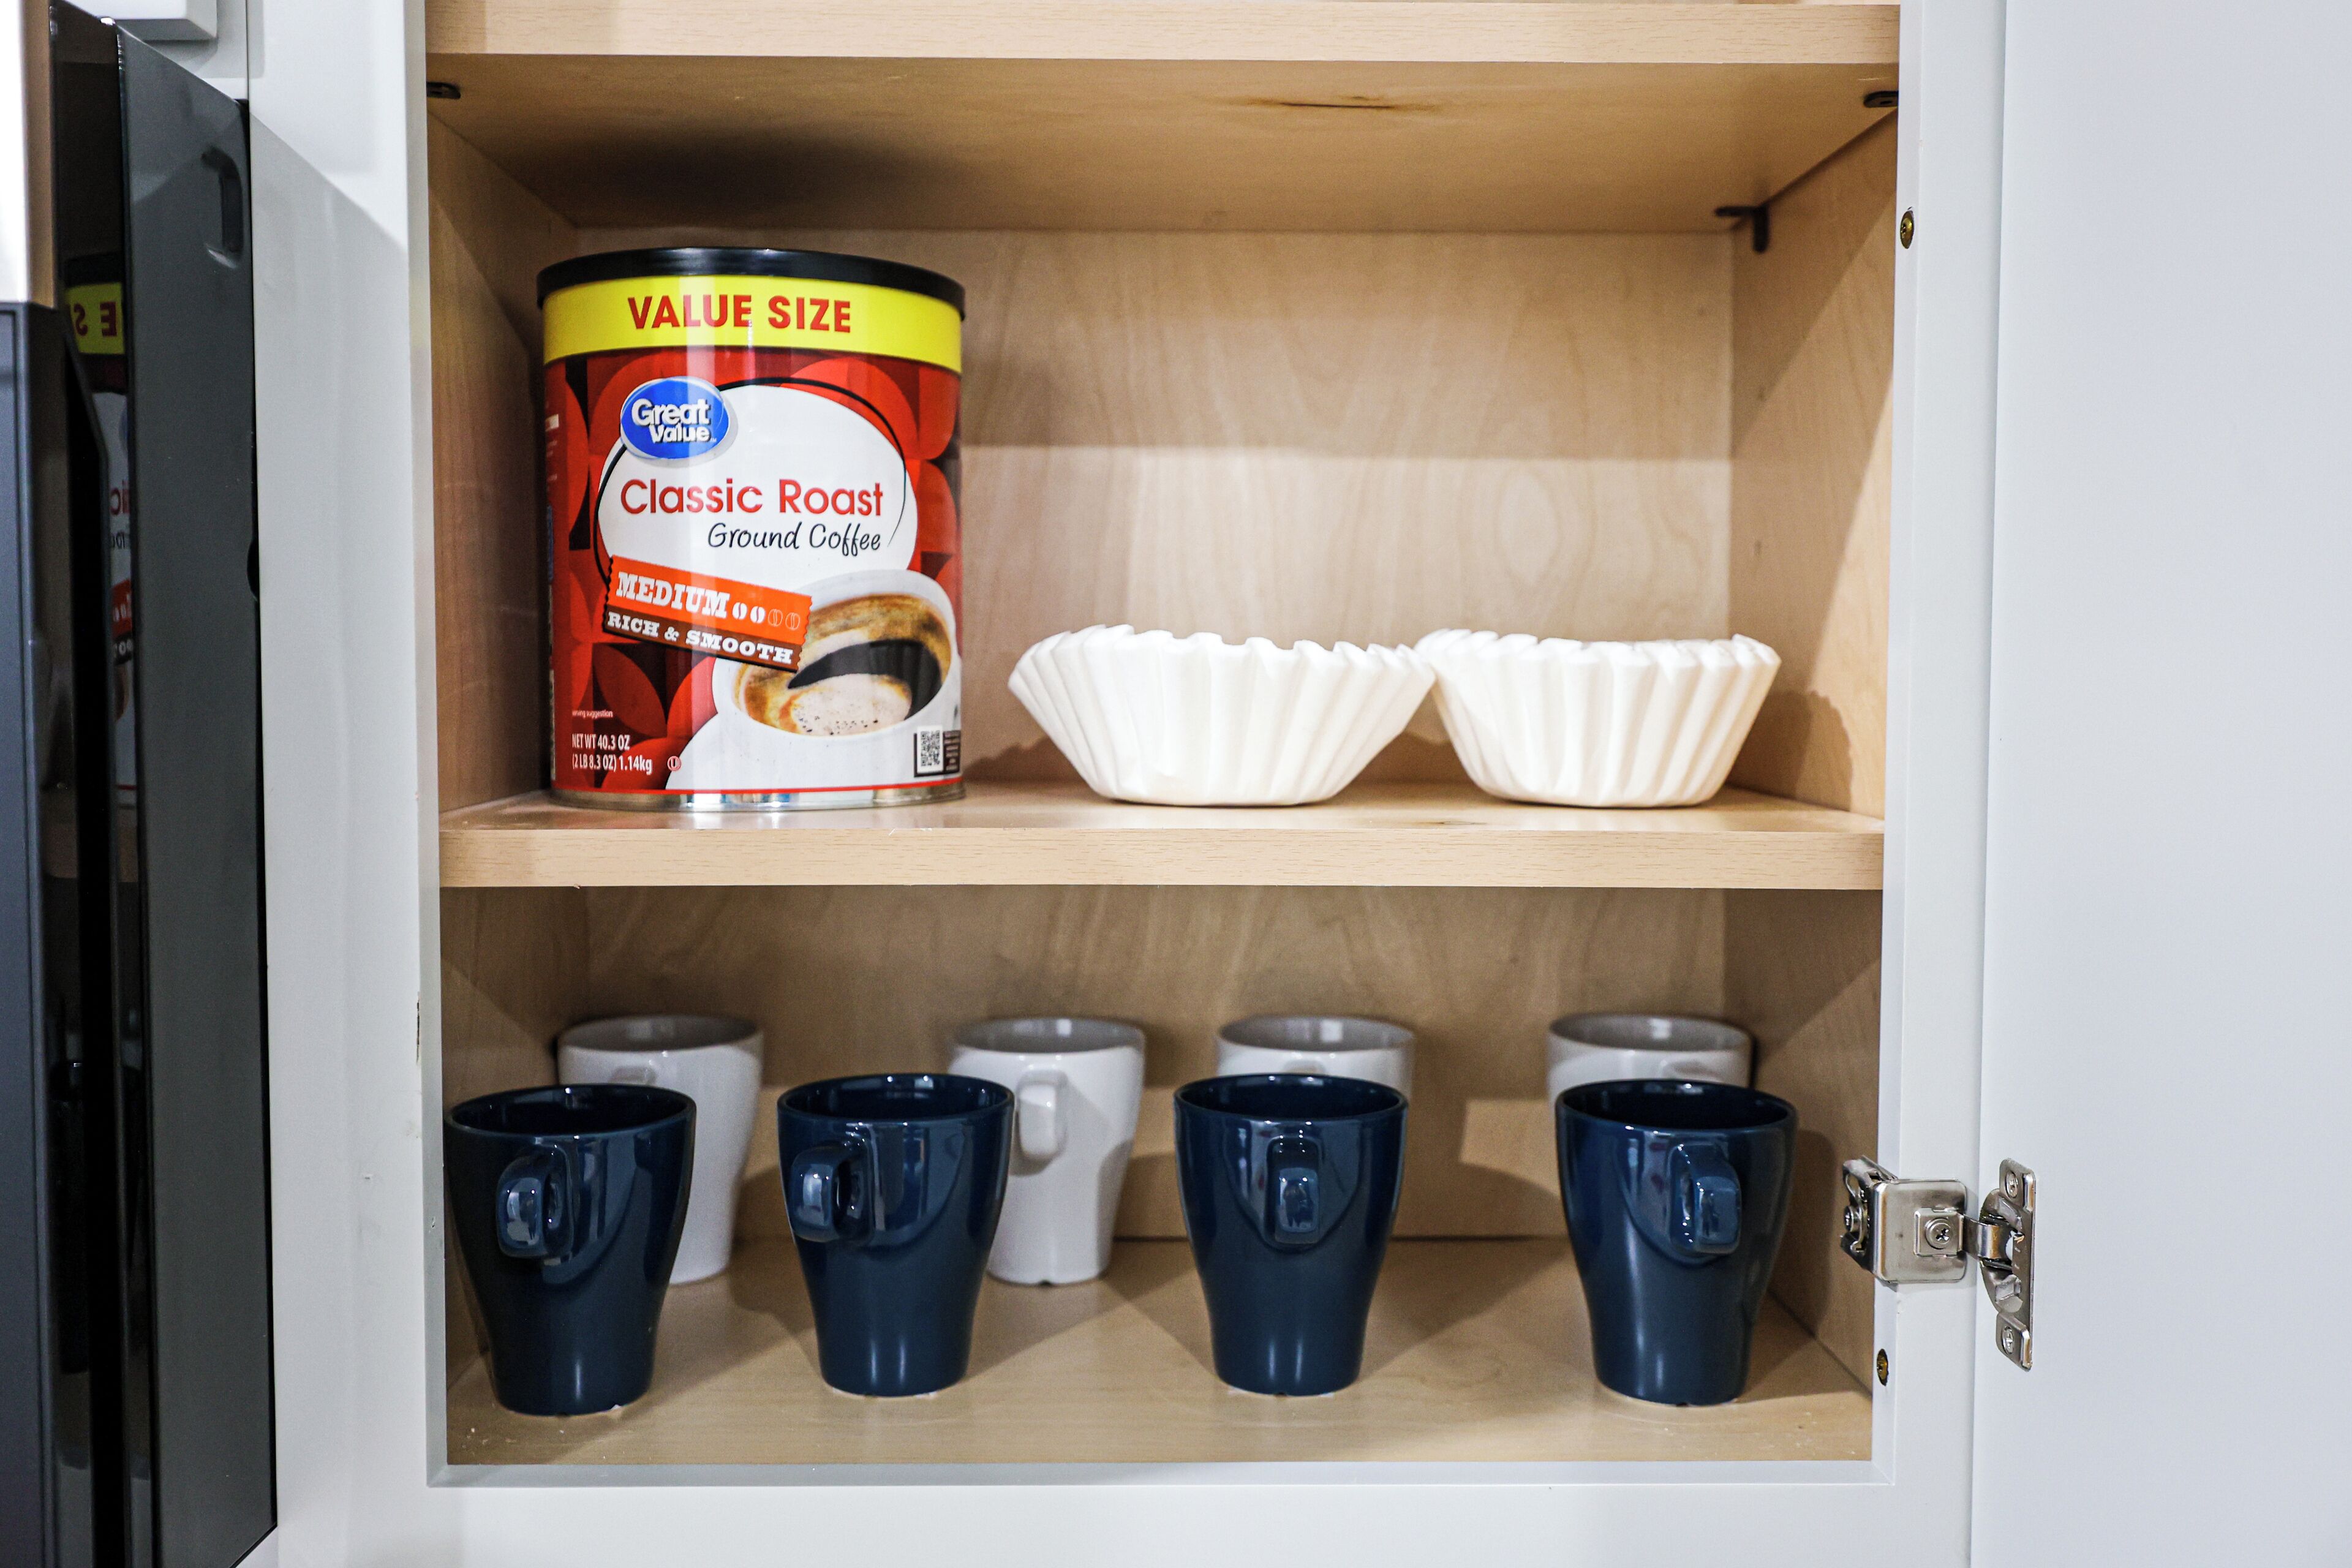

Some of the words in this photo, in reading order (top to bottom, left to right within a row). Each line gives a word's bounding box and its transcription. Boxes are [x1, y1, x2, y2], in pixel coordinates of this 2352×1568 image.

[627, 294, 752, 329] VALUE
[768, 295, 851, 333] SIZE
[631, 398, 710, 426] Great
[649, 423, 711, 443] Value
[620, 478, 763, 514] Classic
[779, 478, 884, 516] Roast
[707, 521, 802, 549] Ground
[809, 522, 881, 557] Coffee
[616, 571, 730, 619] MEDIUM
[607, 611, 660, 638] RICH
[664, 626, 679, 642] &
[685, 630, 793, 664] SMOOTH
[586, 709, 613, 719] suggestion
[572, 733, 583, 748] NET
[584, 734, 596, 749] WT
[597, 734, 616, 750] 40.3
[617, 734, 630, 751] OZ
[572, 753, 578, 770] (2
[579, 753, 588, 769] LB
[589, 754, 601, 770] 8.3
[602, 754, 617, 772] OZ)
[619, 754, 652, 776] 1.14kg
